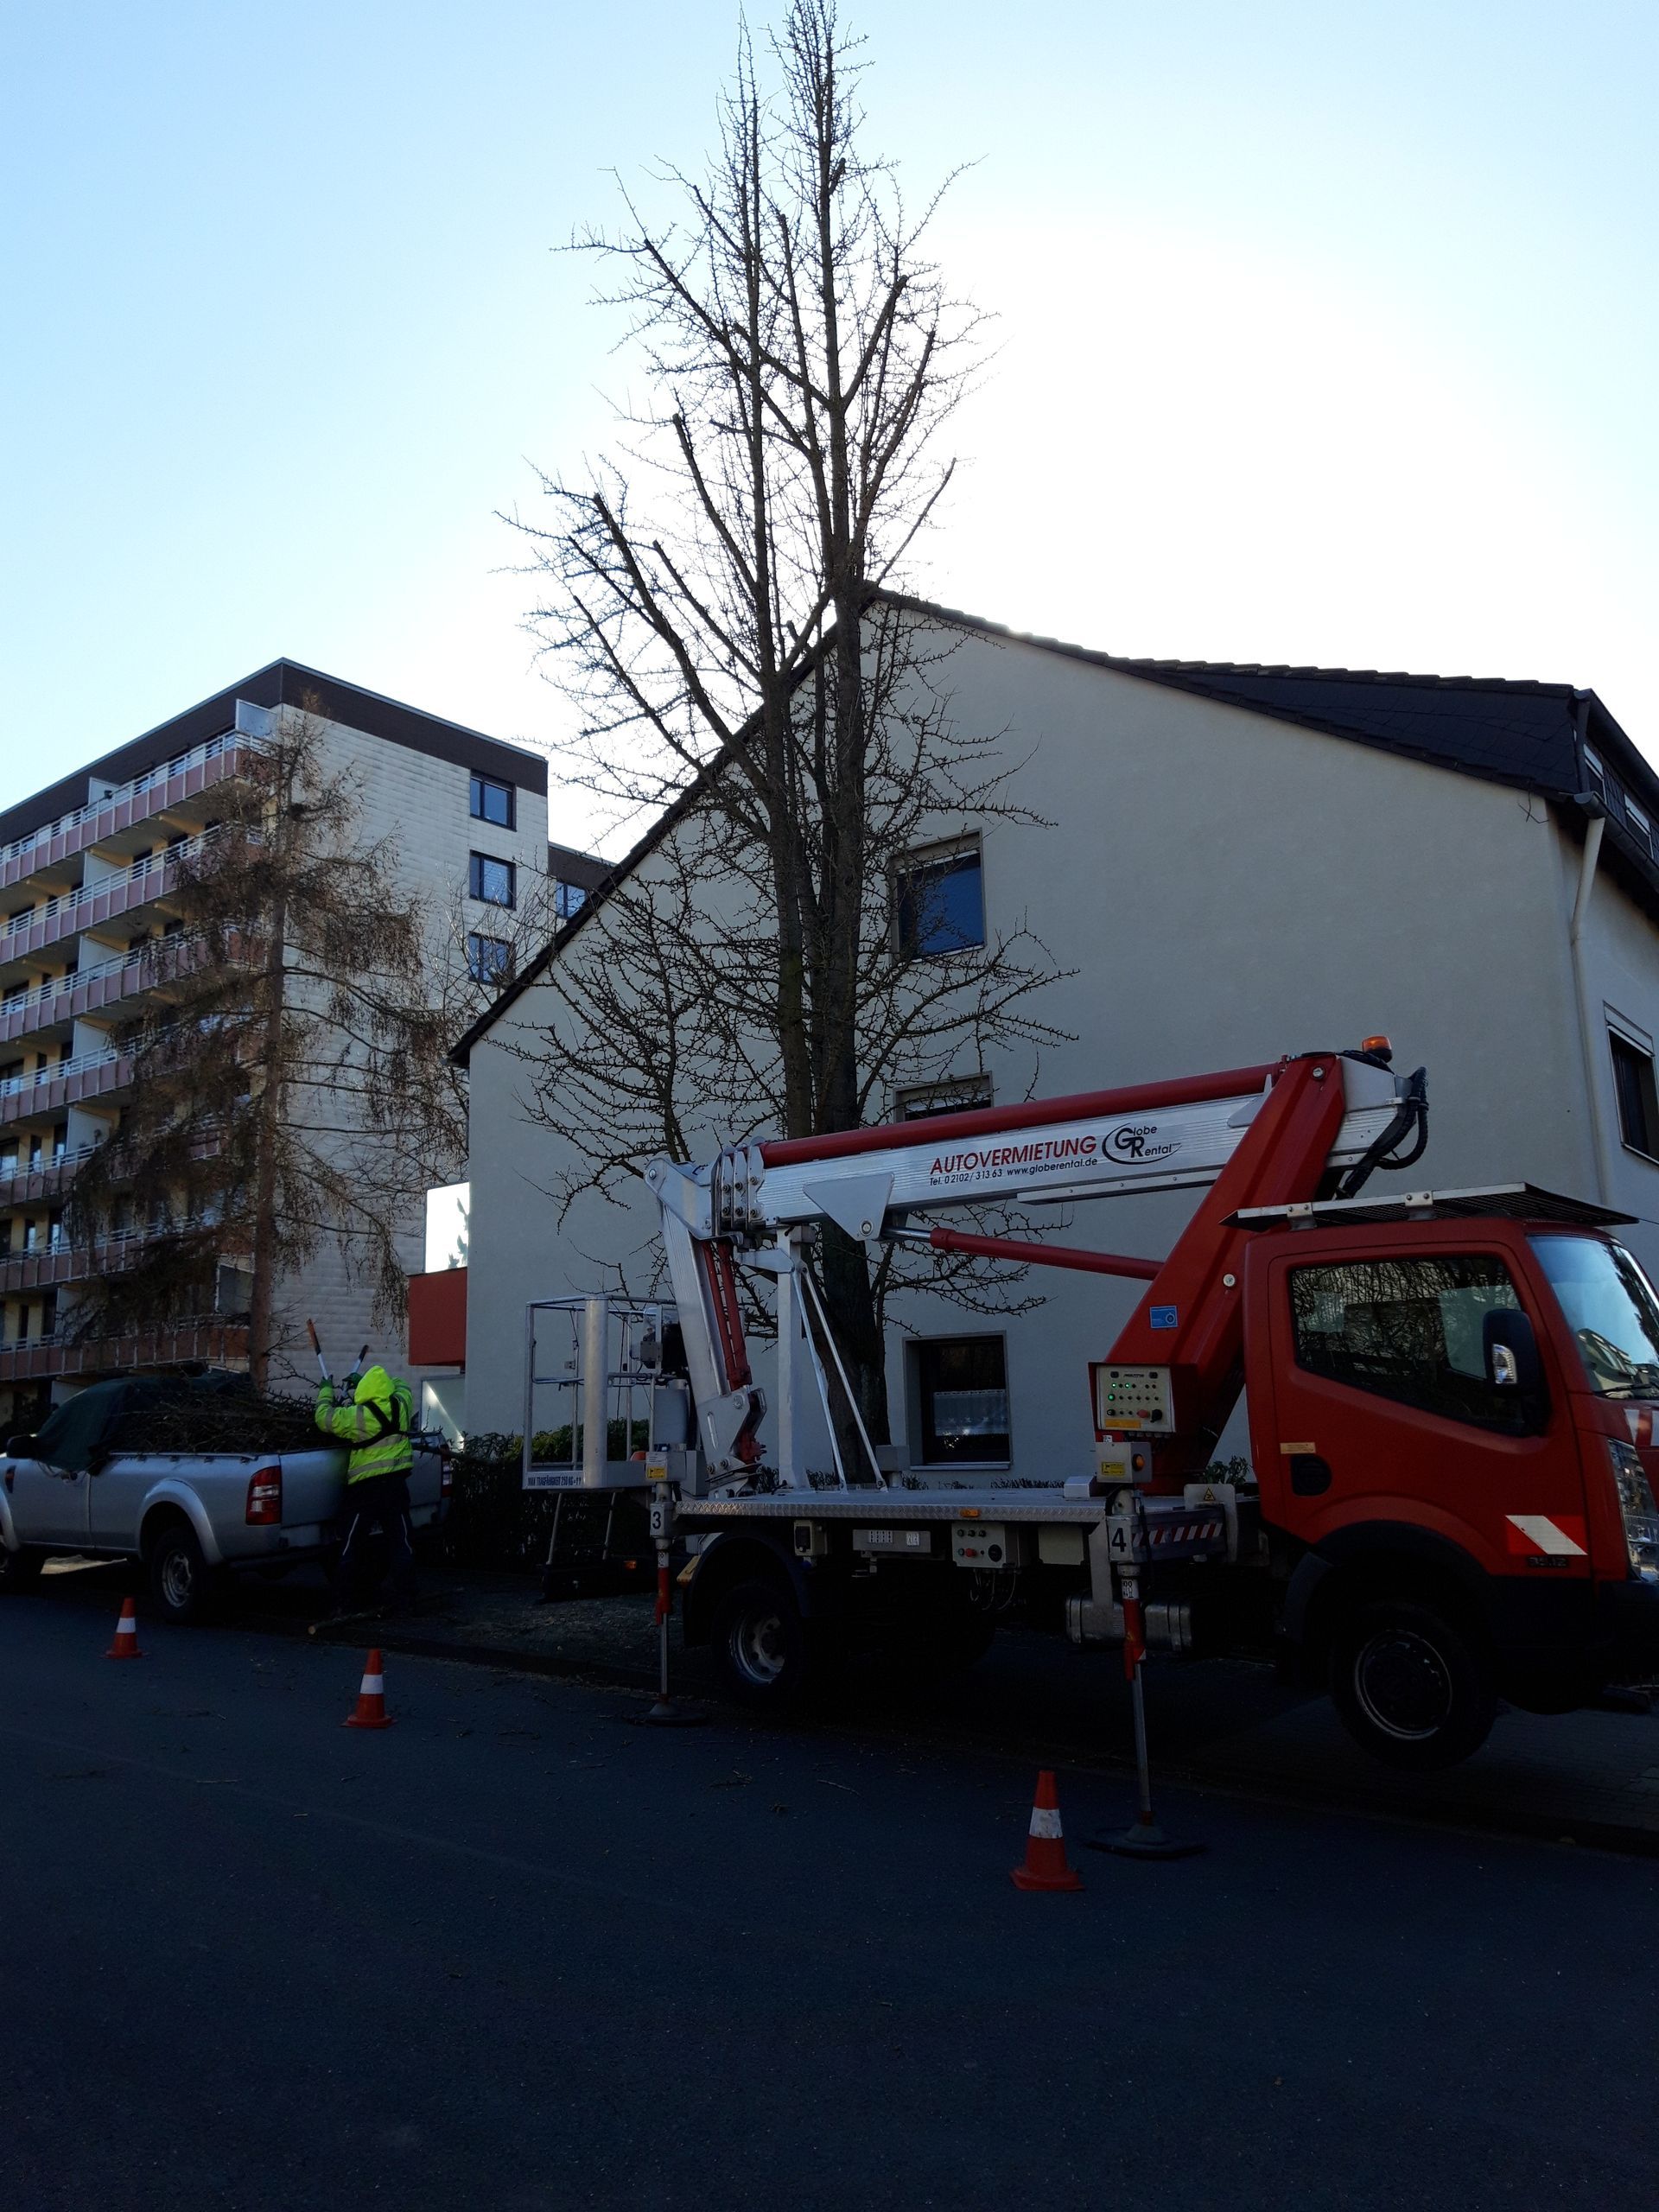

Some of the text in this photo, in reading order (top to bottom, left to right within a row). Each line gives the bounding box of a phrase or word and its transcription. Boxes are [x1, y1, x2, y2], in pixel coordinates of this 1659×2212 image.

[1115, 1126, 1158, 1150] Globe
[1130, 1136, 1173, 1159] Rental
[930, 1135, 1096, 1175] AUTOVERMIETUNG
[930, 1177, 943, 1186] Tel.
[1007, 1158, 1098, 1176] www.globerental.de
[652, 1510, 662, 1529] 3
[1111, 1528, 1127, 1553] 4
